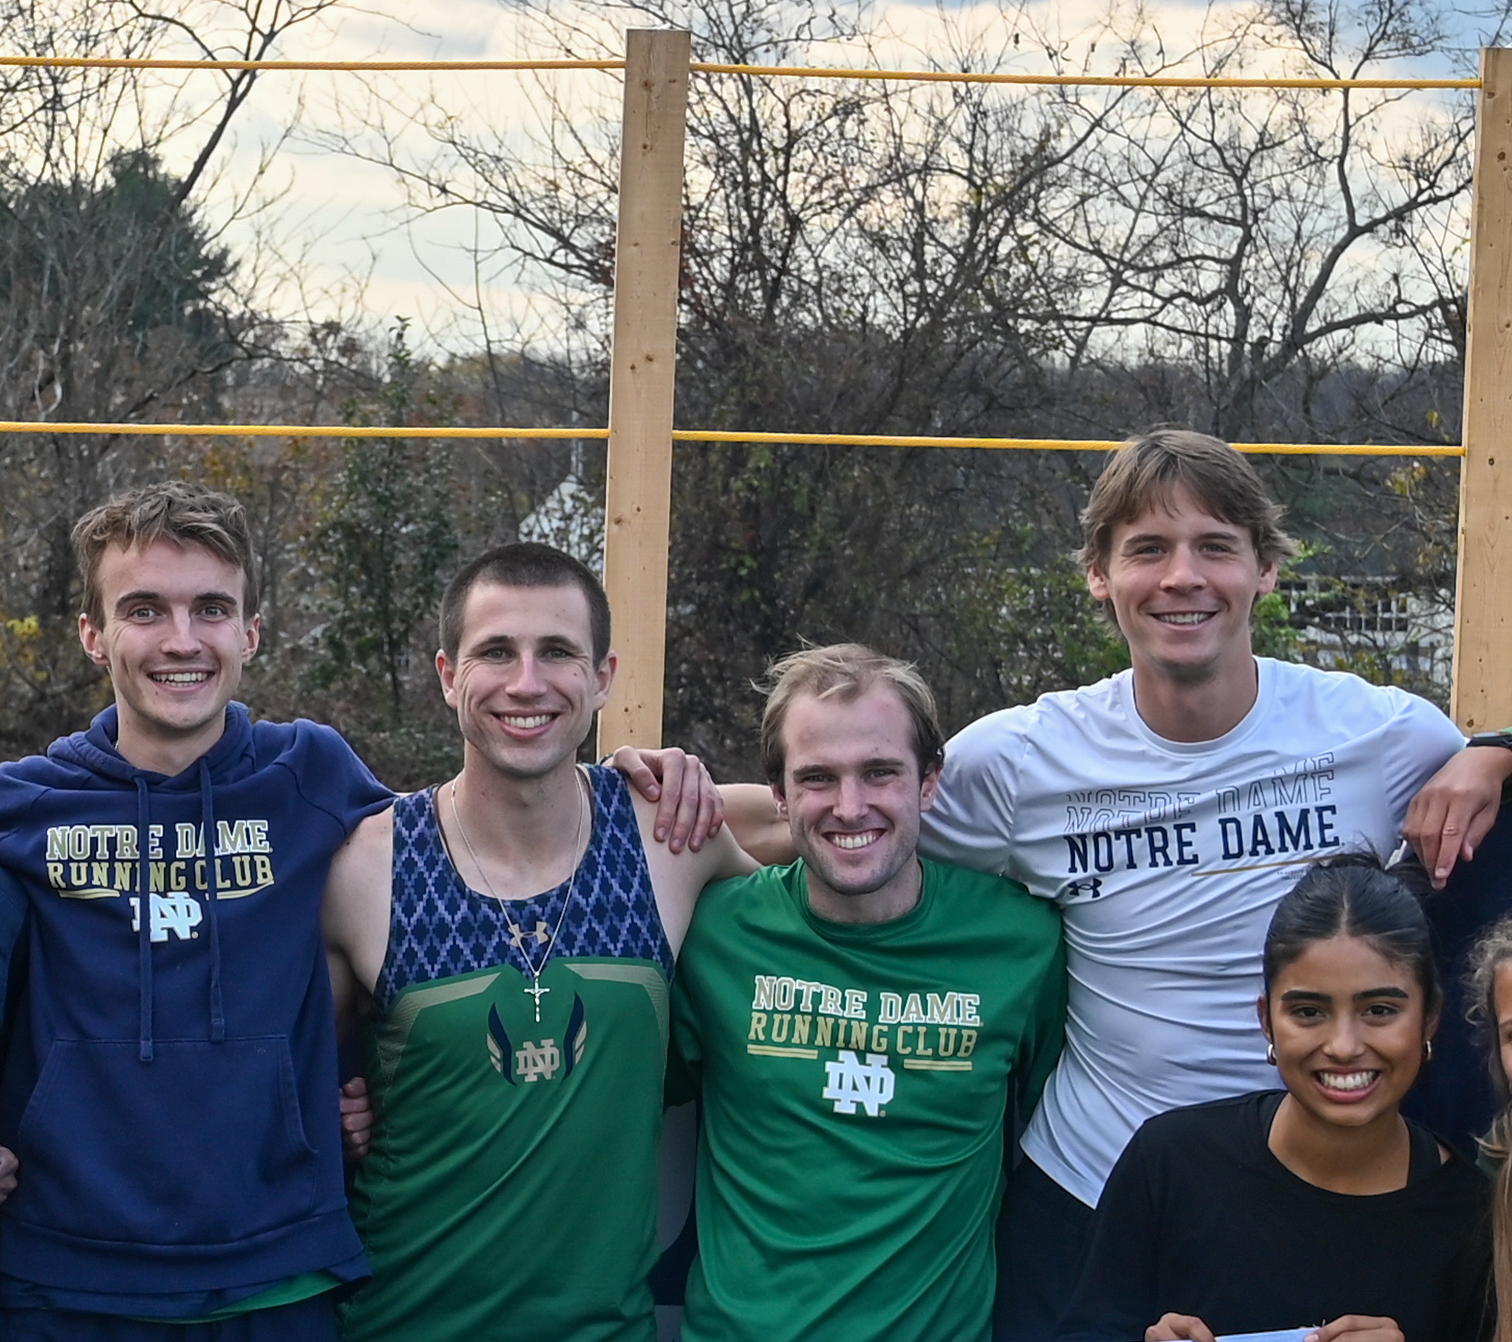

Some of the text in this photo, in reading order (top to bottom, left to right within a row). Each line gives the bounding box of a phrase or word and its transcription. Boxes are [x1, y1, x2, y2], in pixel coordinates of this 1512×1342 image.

[46, 819, 270, 861] NOTRE DAME
[1064, 804, 1340, 874] NOTRE DAME
[46, 855, 274, 893] RUNNING CLUB
[752, 975, 981, 1027] NOTRE DAME
[748, 1012, 979, 1058] RUNNING CLUB
